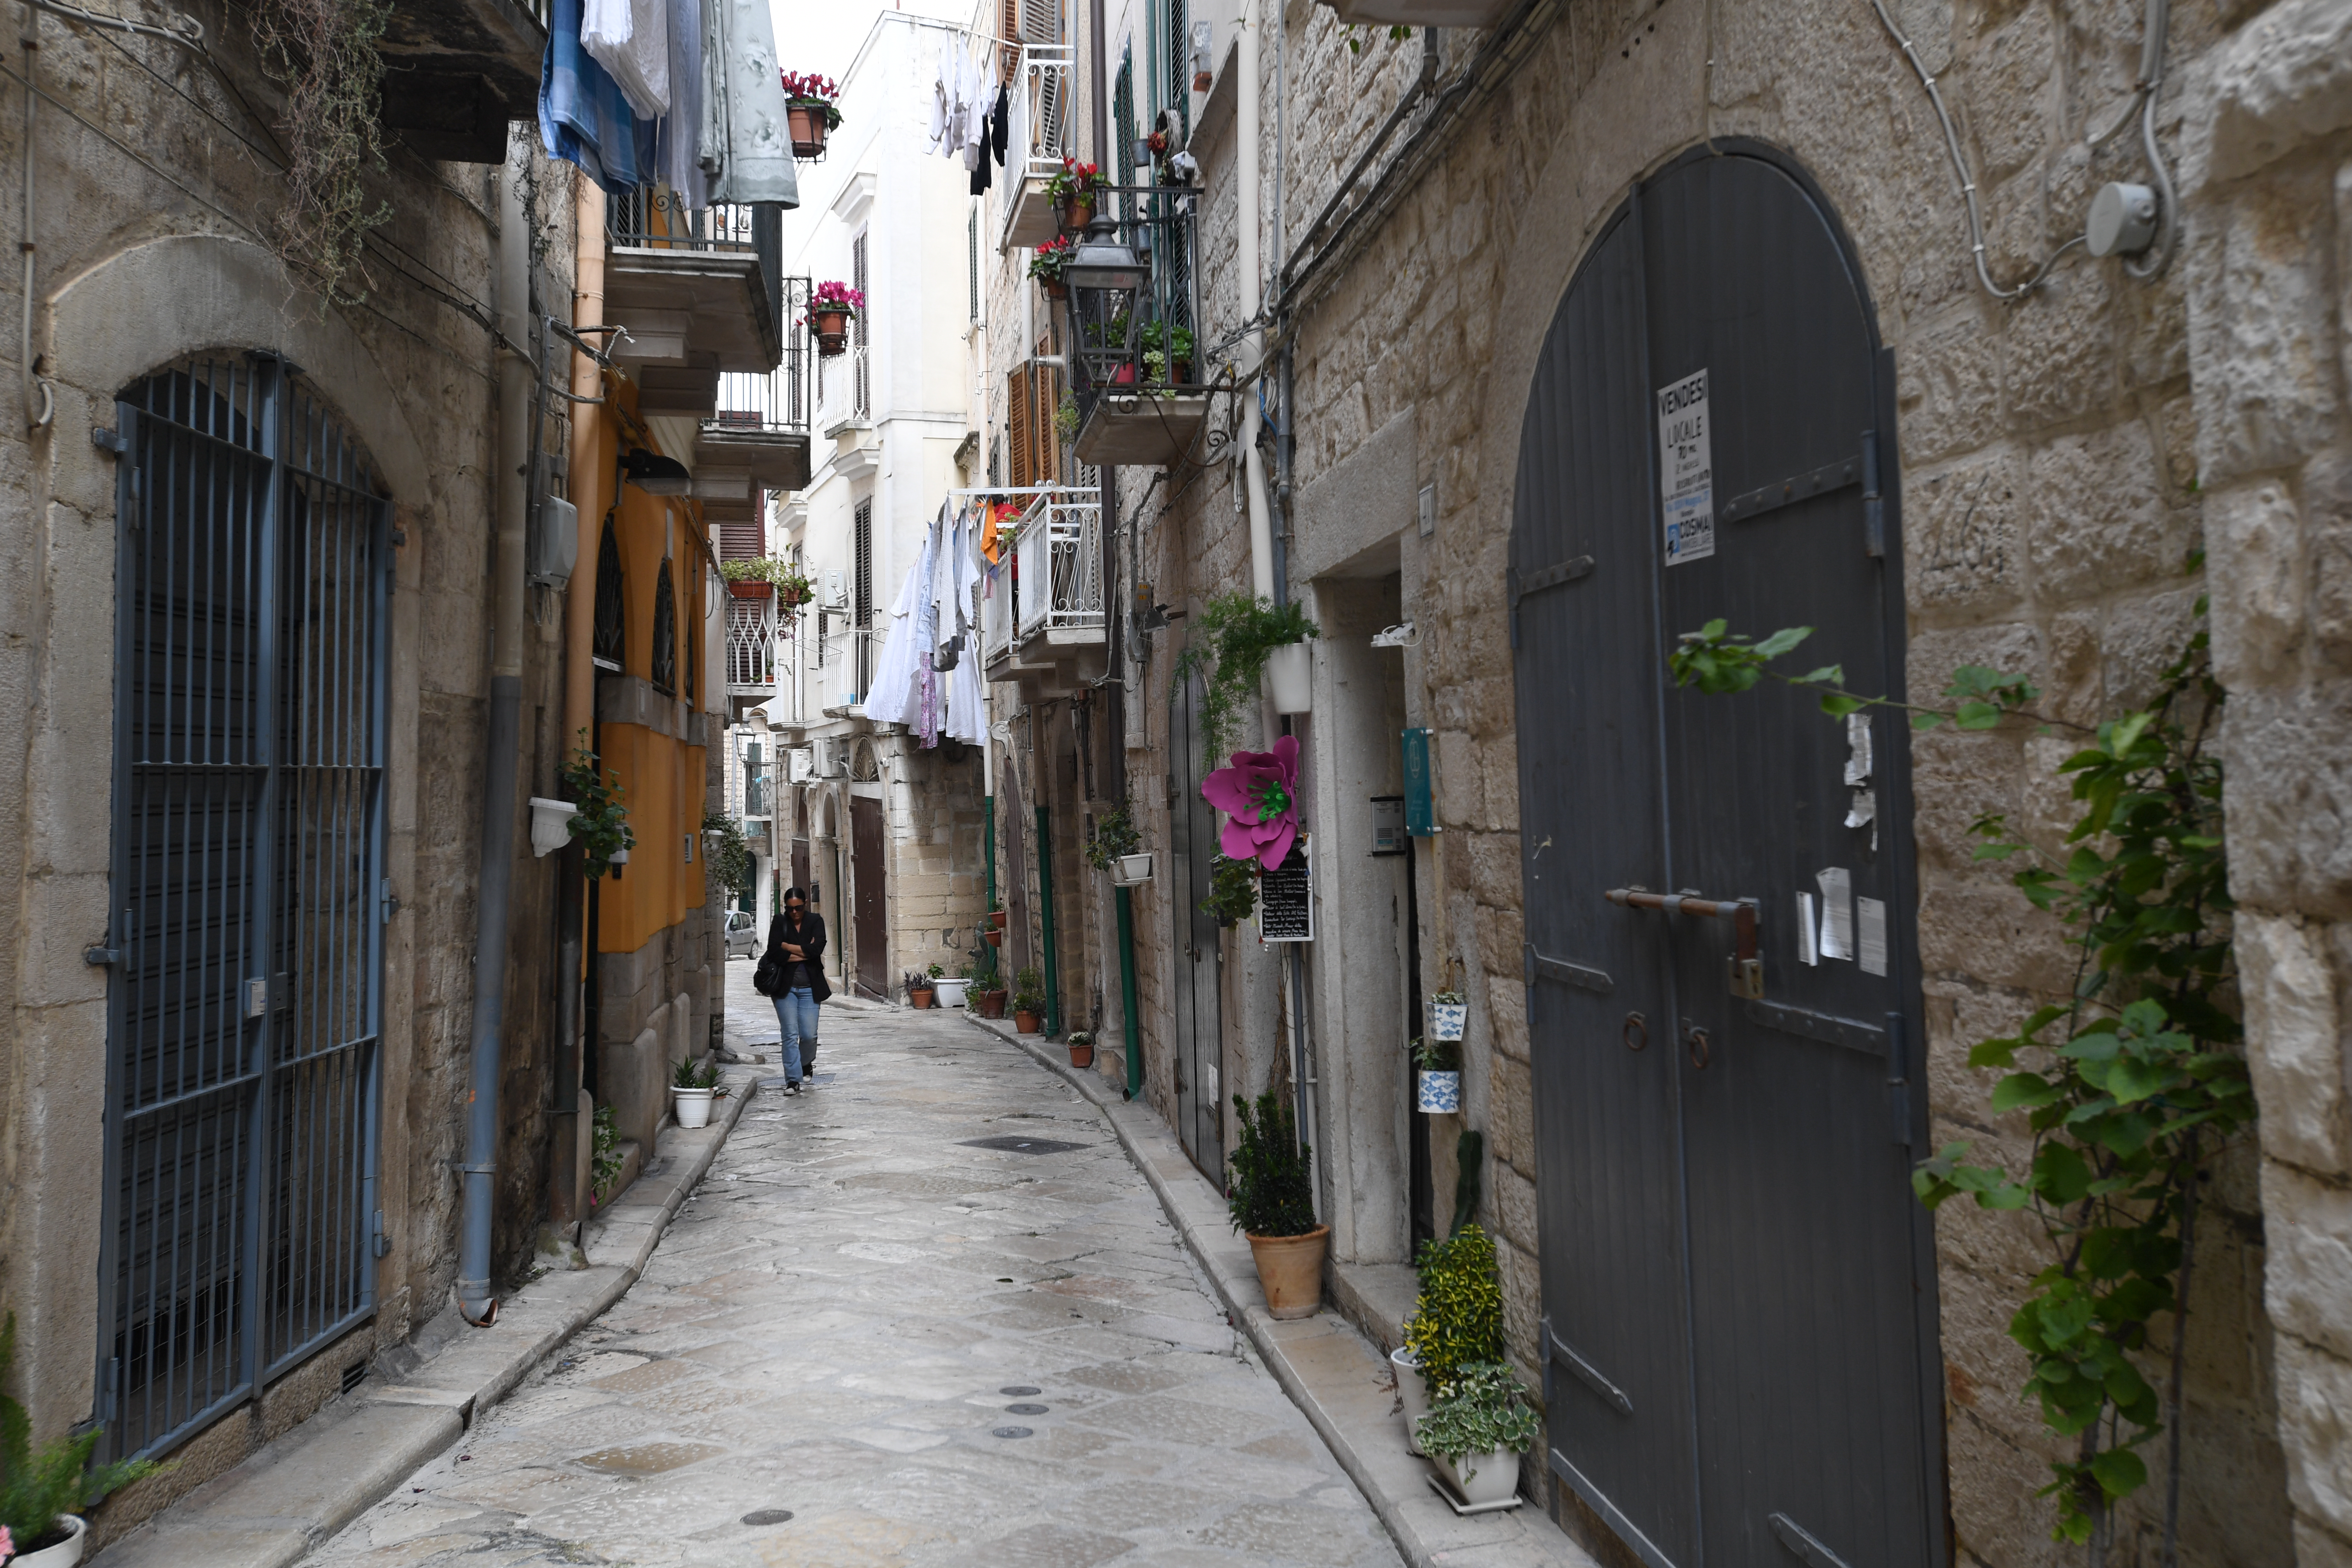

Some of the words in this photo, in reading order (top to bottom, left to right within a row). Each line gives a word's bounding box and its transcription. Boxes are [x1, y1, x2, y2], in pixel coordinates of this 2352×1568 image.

[1660, 374, 1708, 417] VENDESI
[1666, 416, 1702, 448] LOCALE
[1680, 512, 1713, 539] COSMAI
